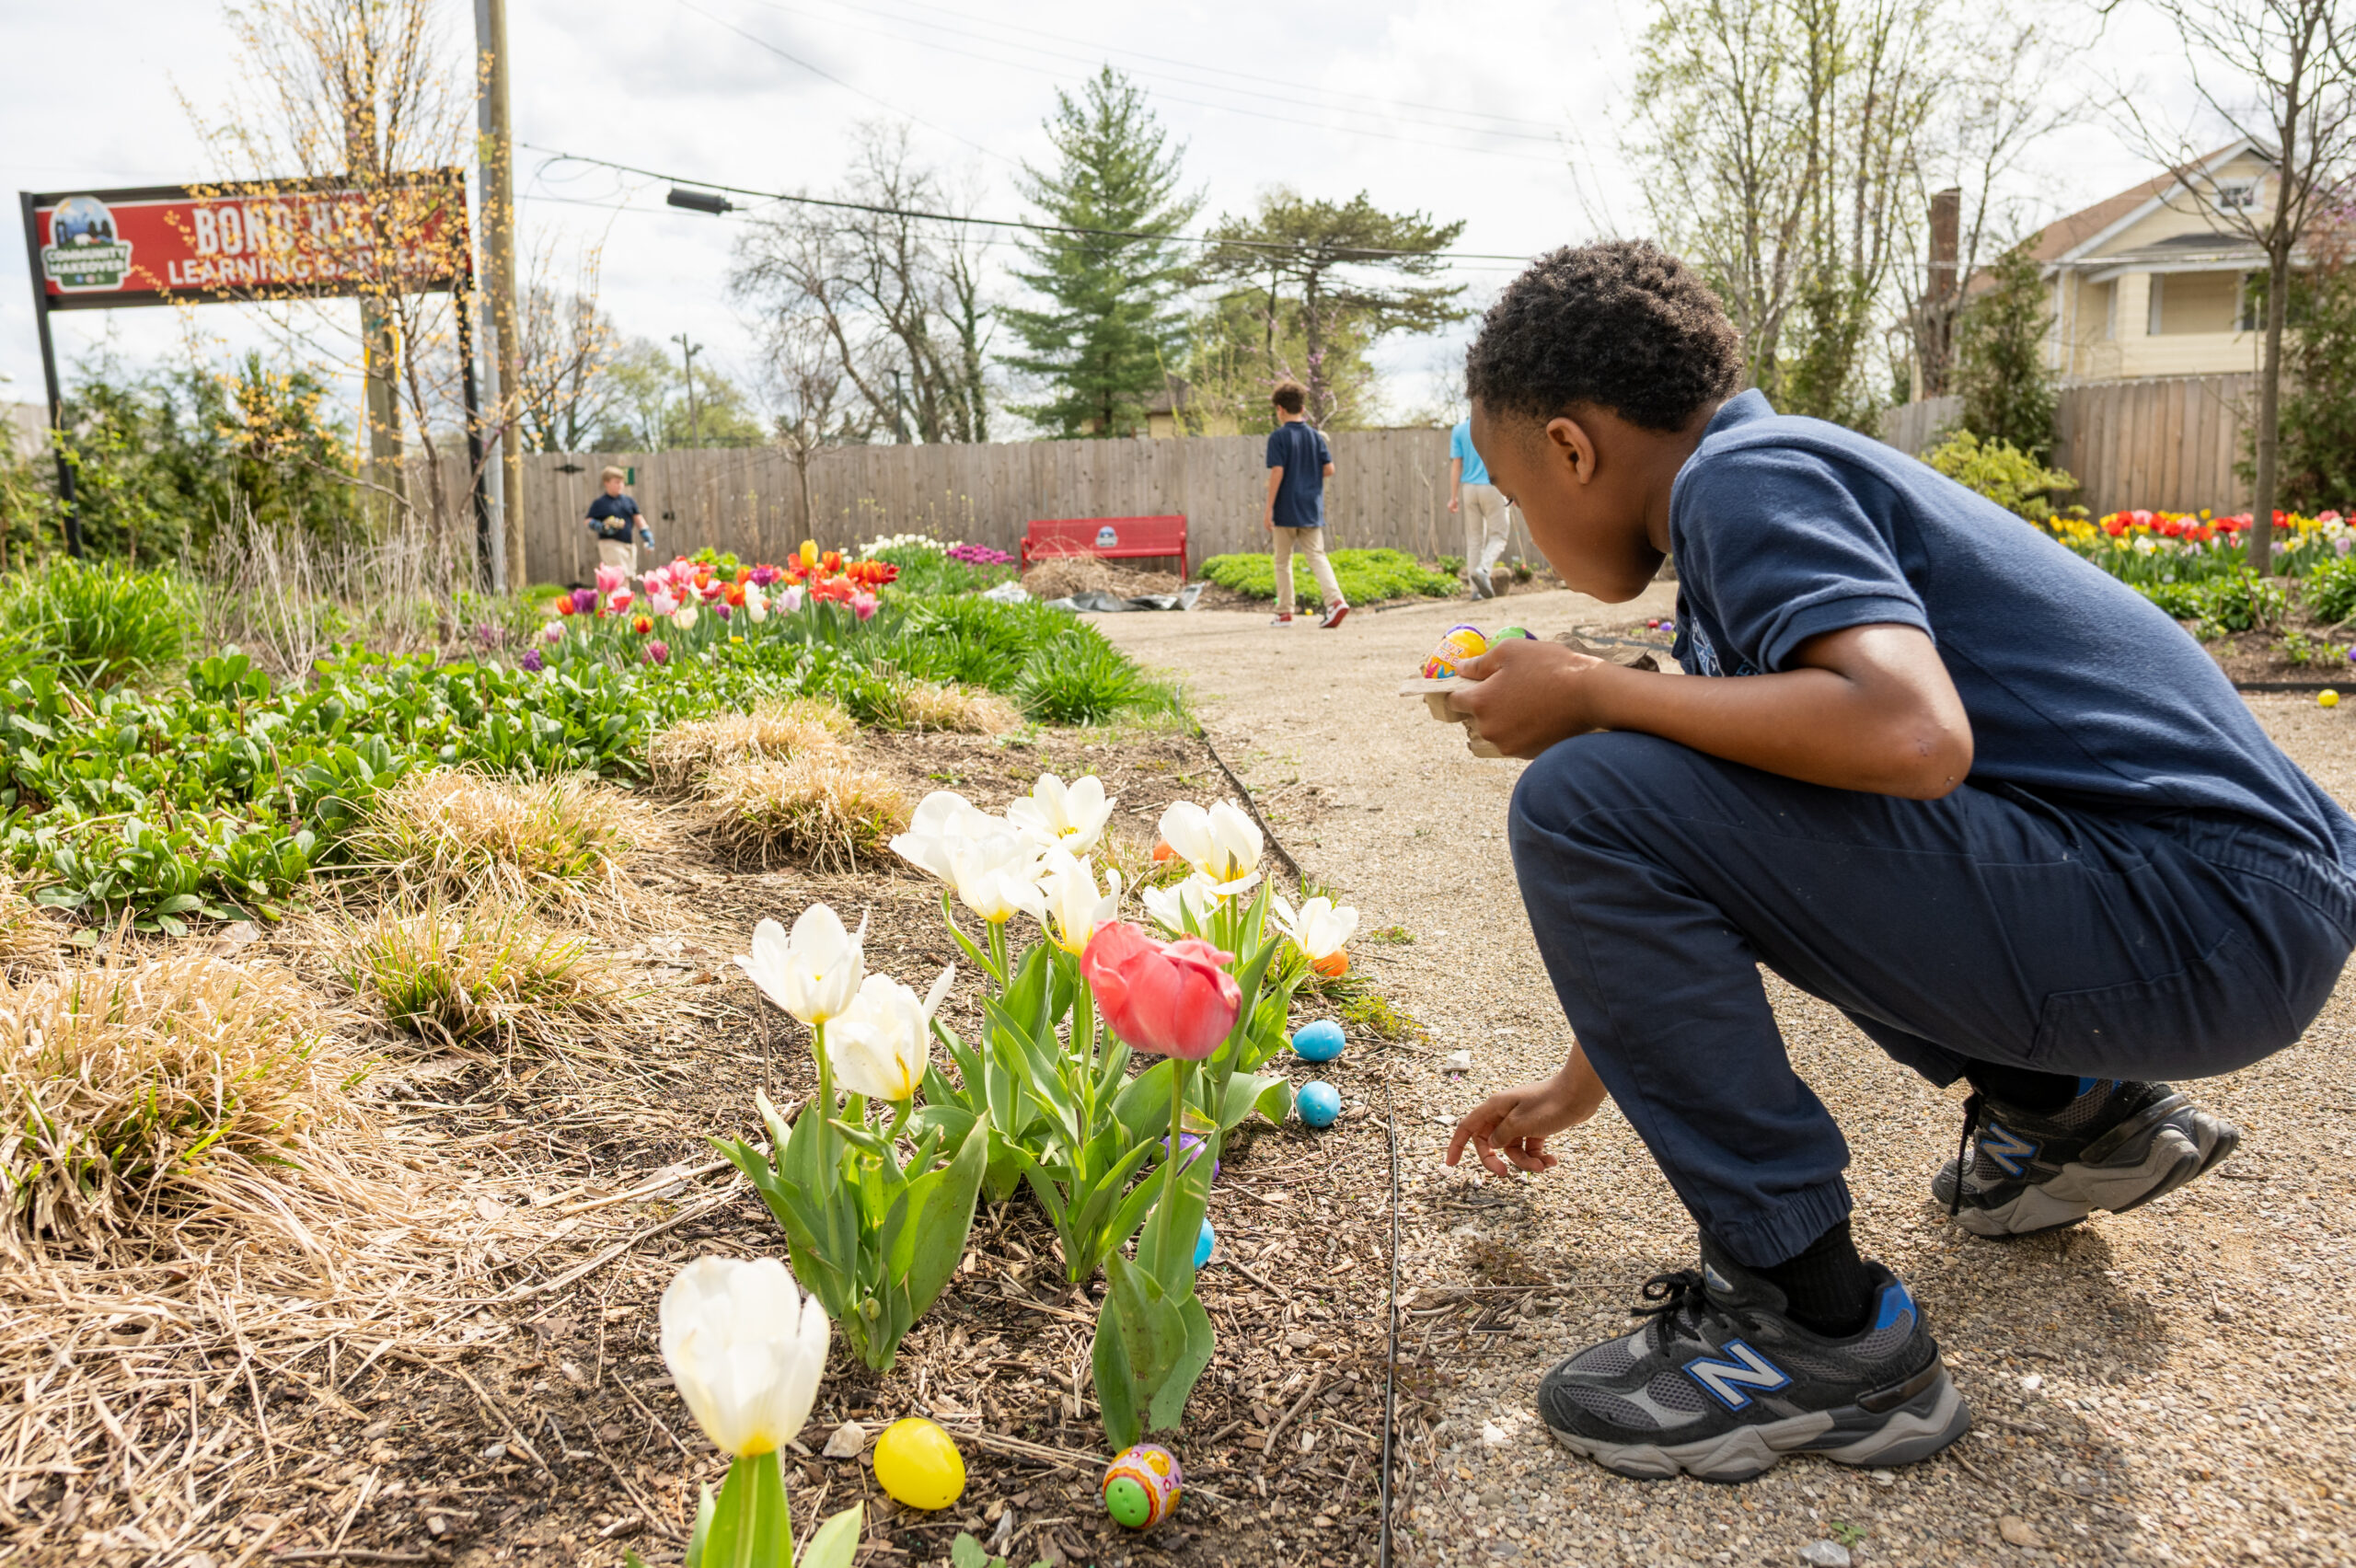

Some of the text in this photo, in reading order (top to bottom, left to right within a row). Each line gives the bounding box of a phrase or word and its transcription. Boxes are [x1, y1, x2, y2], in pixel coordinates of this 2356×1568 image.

[191, 198, 401, 256] BOND HIL
[46, 247, 126, 261] COMMUNITY
[50, 259, 124, 274] MAKEOVER
[167, 254, 310, 284] LEARNING
[1981, 1123, 2036, 1176] N
[1682, 1338, 1792, 1411] N
